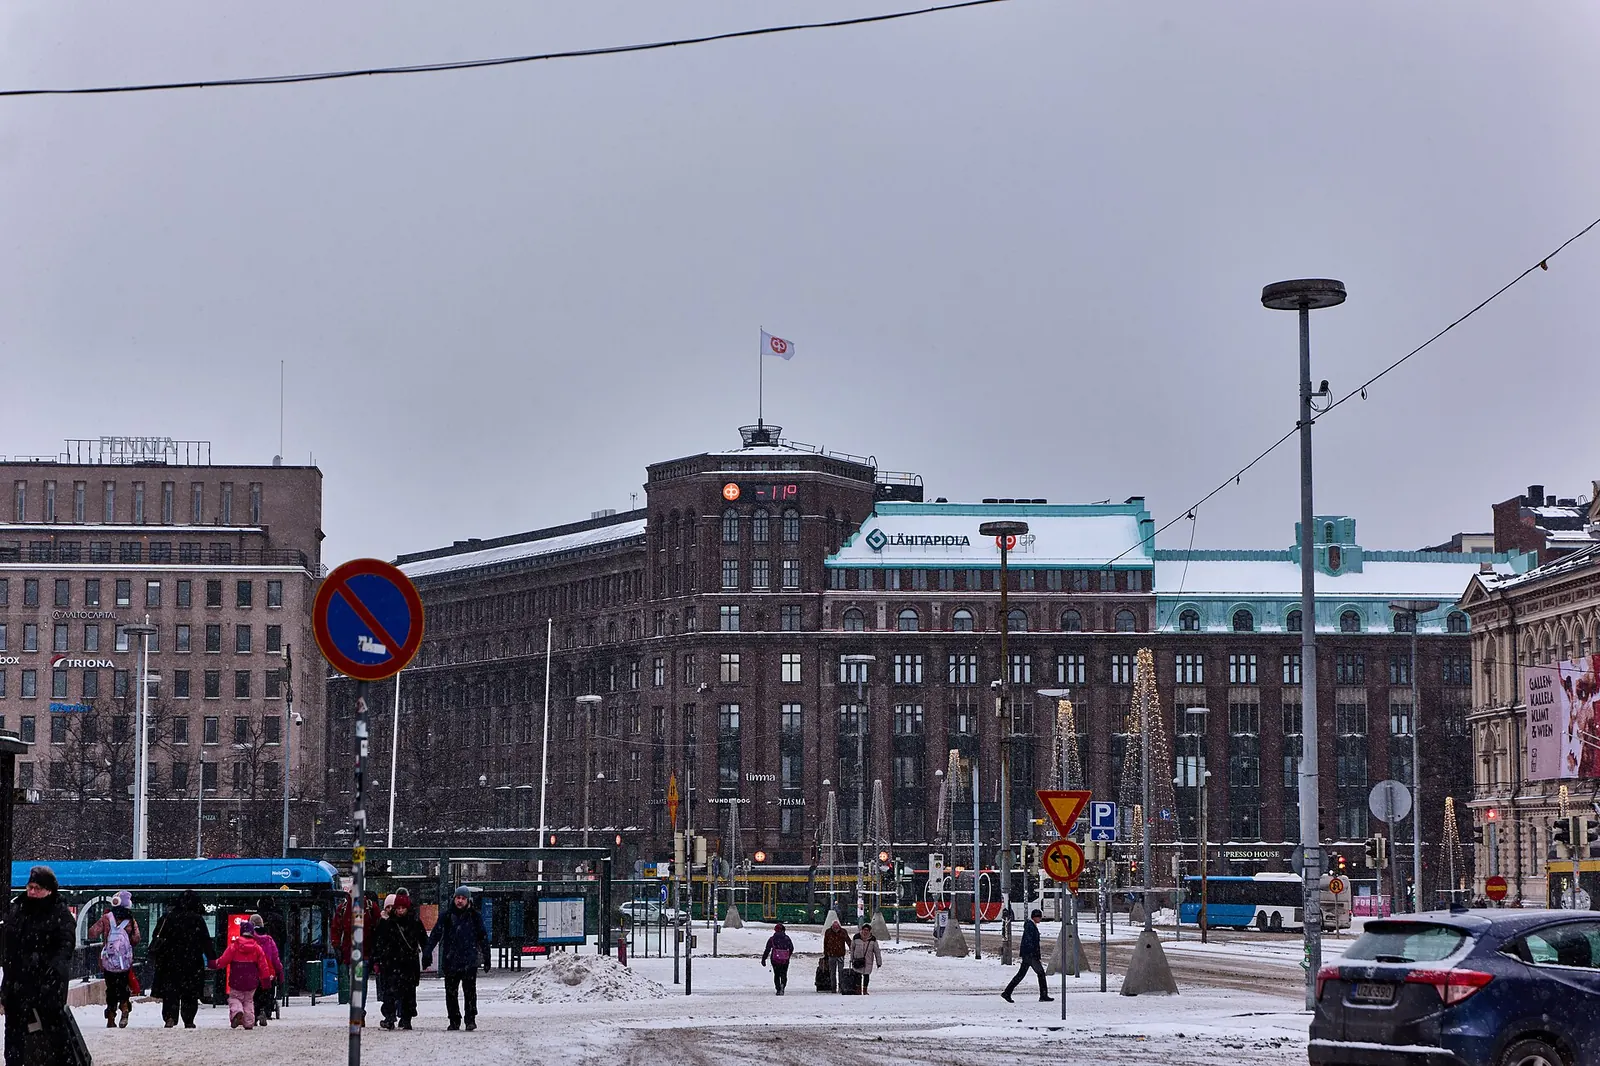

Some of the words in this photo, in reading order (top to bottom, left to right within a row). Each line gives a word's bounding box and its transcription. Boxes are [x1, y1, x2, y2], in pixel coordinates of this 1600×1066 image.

[100, 436, 177, 454] FENNIA
[890, 533, 970, 546] LÄHITAPIOLA
[67, 659, 114, 668] TRIONA
[1530, 692, 1554, 707] KALLELA
[1531, 708, 1549, 723] KLIMT
[1537, 724, 1553, 738] WIEN
[745, 773, 775, 782] timma
[1095, 804, 1112, 826] P
